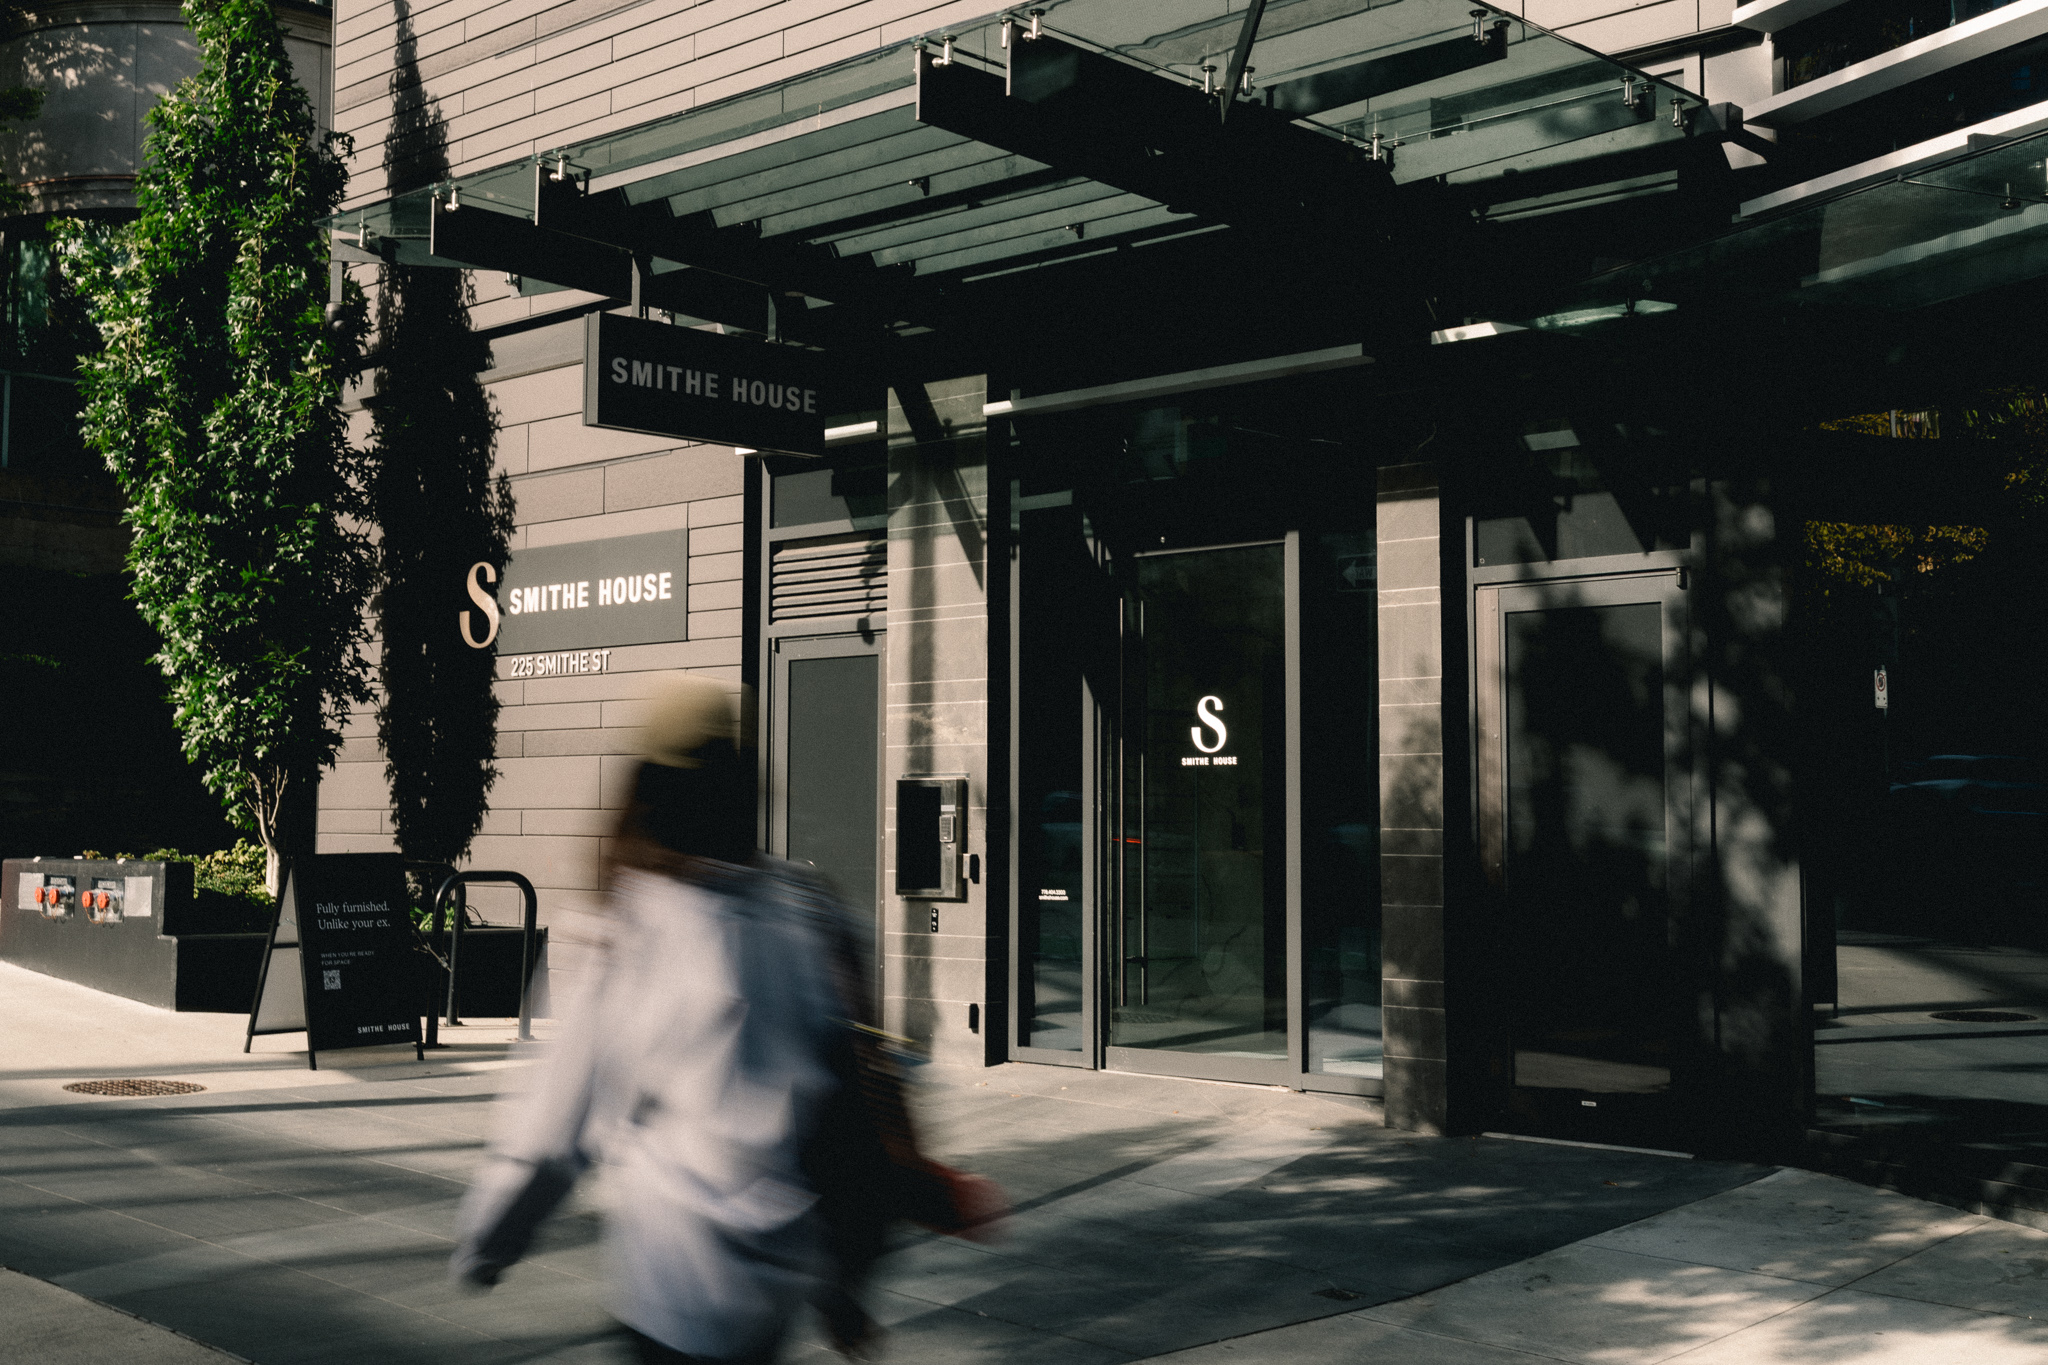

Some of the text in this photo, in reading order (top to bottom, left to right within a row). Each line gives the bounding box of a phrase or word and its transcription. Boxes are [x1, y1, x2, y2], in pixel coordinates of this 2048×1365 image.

[611, 357, 817, 414] SMITHE HOUSE
[459, 561, 500, 649] S
[509, 572, 672, 615] SMITHE HOUSE
[510, 650, 611, 677] 225 SMITHE ST
[1191, 695, 1227, 754] S
[1181, 756, 1238, 766] SMITHE HOUSE
[316, 901, 390, 916] Fully furnished.
[317, 918, 391, 931] Unlike your ex.
[357, 1023, 411, 1034] SMITHE HOUSE
